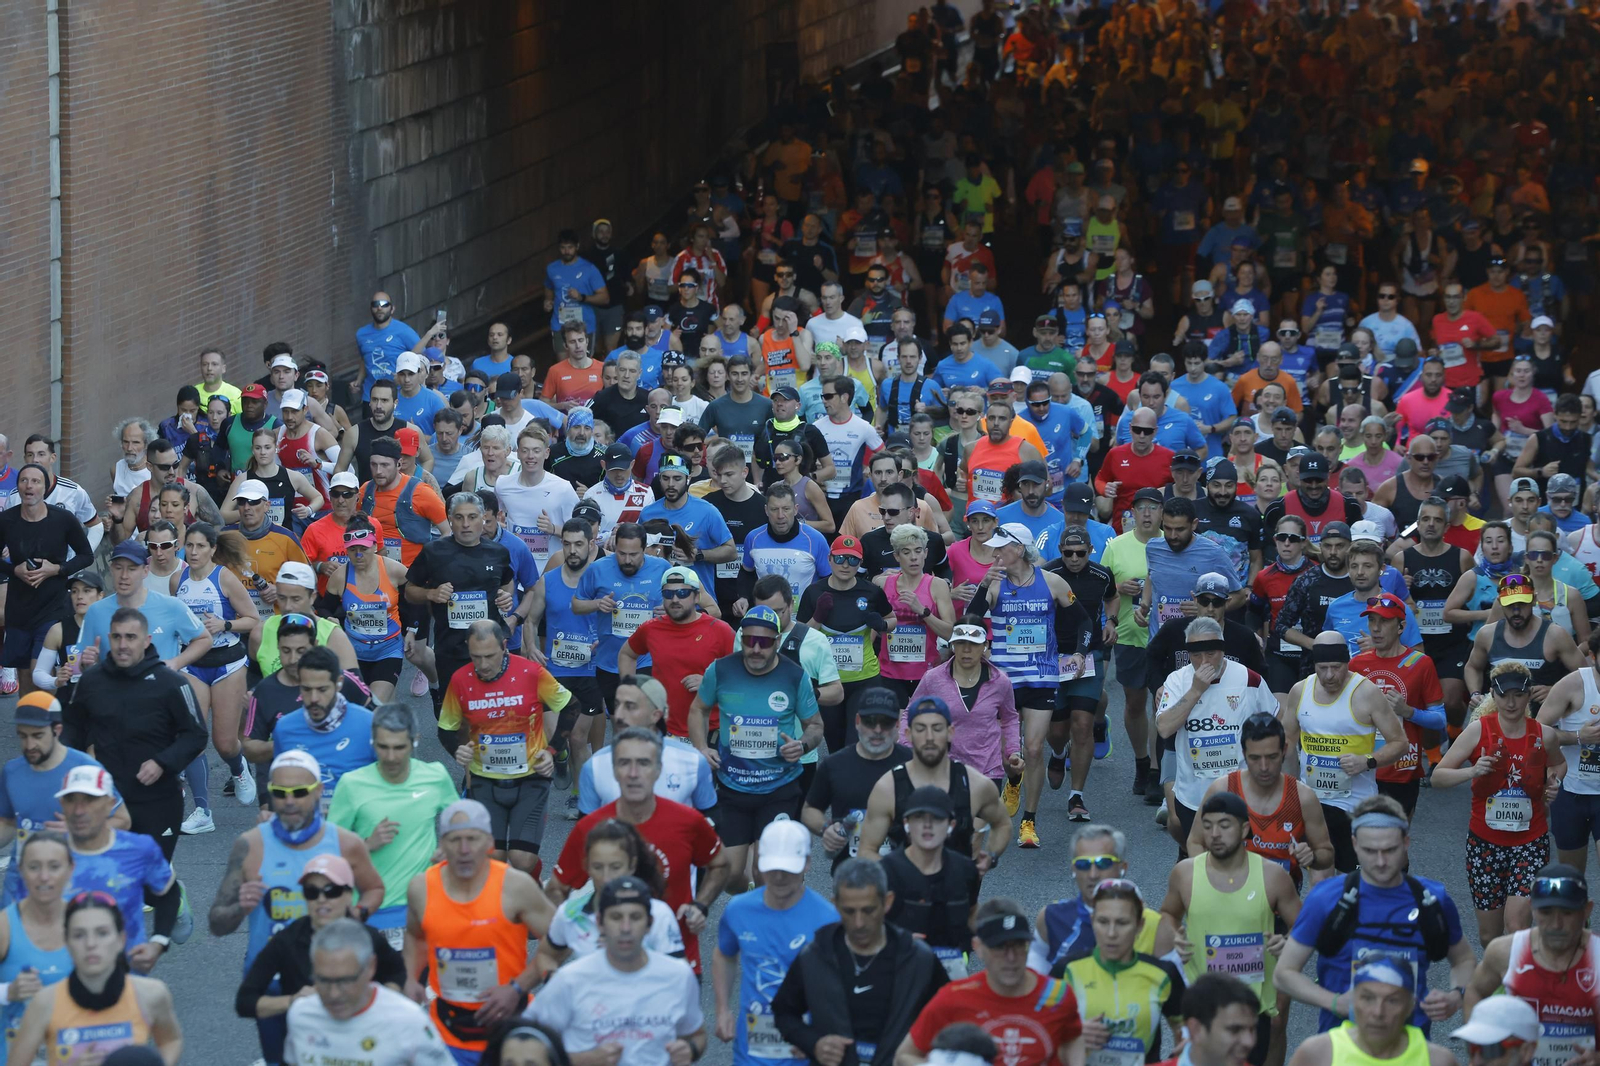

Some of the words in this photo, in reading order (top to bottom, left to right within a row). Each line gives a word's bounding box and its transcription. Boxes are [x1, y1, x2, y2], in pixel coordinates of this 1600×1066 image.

[759, 557, 797, 565] RUNNERS
[450, 610, 485, 620] DAVISICO
[1422, 618, 1443, 626] DAVID
[1018, 636, 1035, 644] PITU
[889, 643, 922, 653] GORRIÓN
[556, 651, 585, 661] GERARD
[468, 694, 524, 711] BUDAPEST
[487, 709, 505, 719] 42.2
[494, 735, 520, 743] ZURICH
[730, 739, 777, 749] CHRISTOPHE
[1204, 736, 1231, 745] ZURICH
[1306, 744, 1341, 752] STRIDERS
[490, 755, 517, 765] BMMH
[1192, 762, 1201, 770] EL
[1201, 759, 1238, 769] SEVILLISTA
[1320, 759, 1340, 767] ZURIC
[1319, 771, 1336, 779] 11734
[1316, 779, 1339, 789] DAVE
[1495, 811, 1524, 821] DIANA
[1225, 936, 1256, 945] ZURICH
[1226, 952, 1243, 960] 8520
[1207, 960, 1264, 973] ALEJANDRO
[1542, 1004, 1594, 1017] ALTACASA
[1549, 1026, 1587, 1035] ZURICH
[1108, 1039, 1137, 1050] URICH
